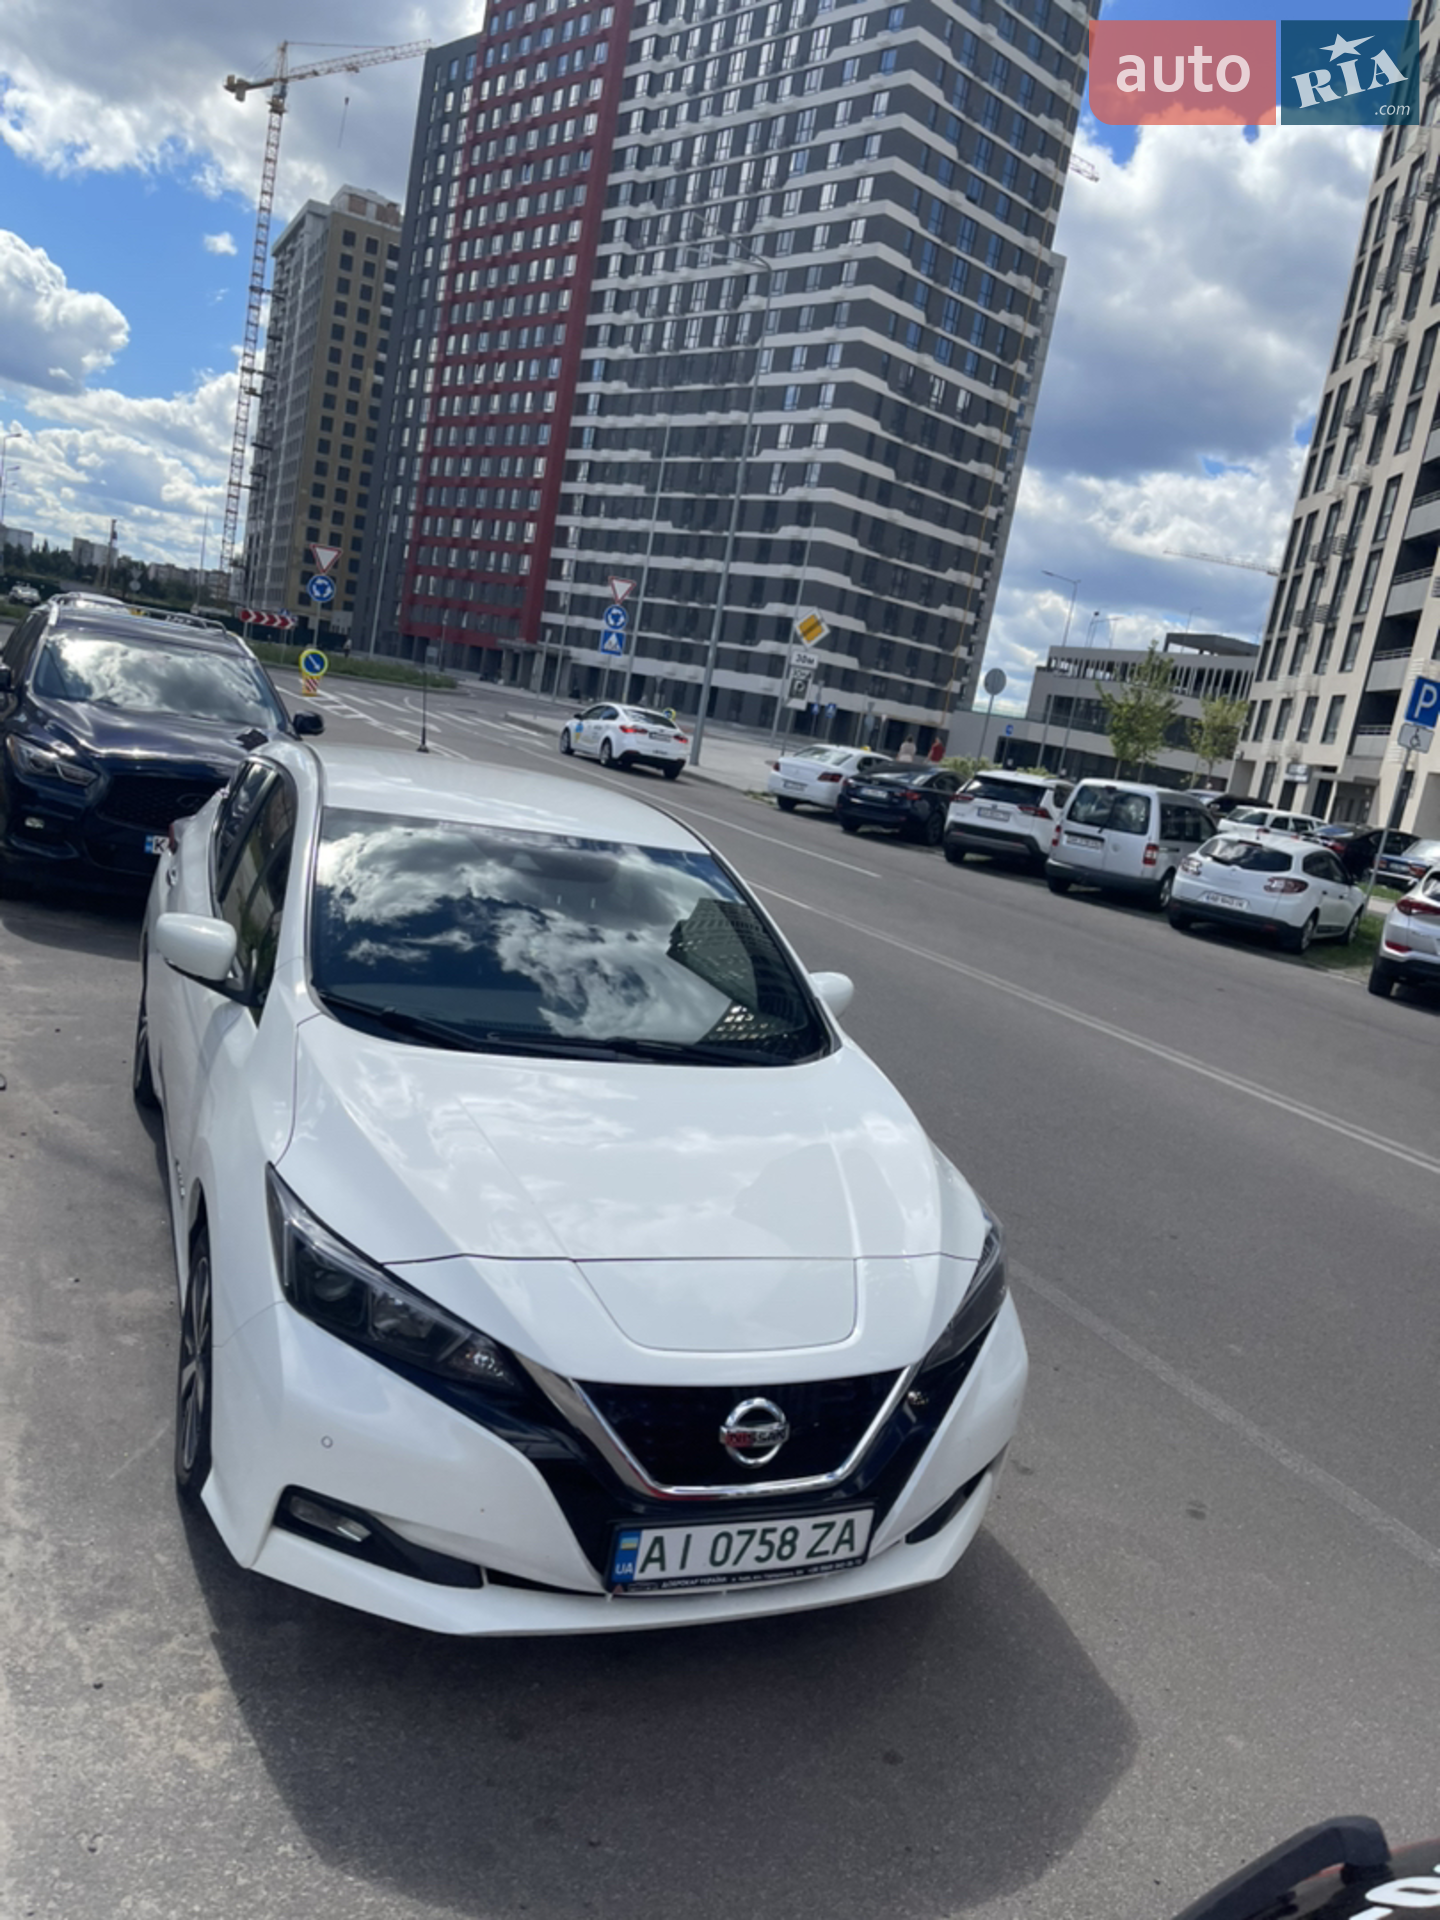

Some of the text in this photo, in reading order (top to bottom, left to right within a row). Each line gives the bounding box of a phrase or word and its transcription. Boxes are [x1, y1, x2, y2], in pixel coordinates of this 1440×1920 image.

[1413, 682, 1438, 719] P
[639, 1518, 856, 1573] AI 0758 ZA
[615, 1562, 634, 1575] UA
